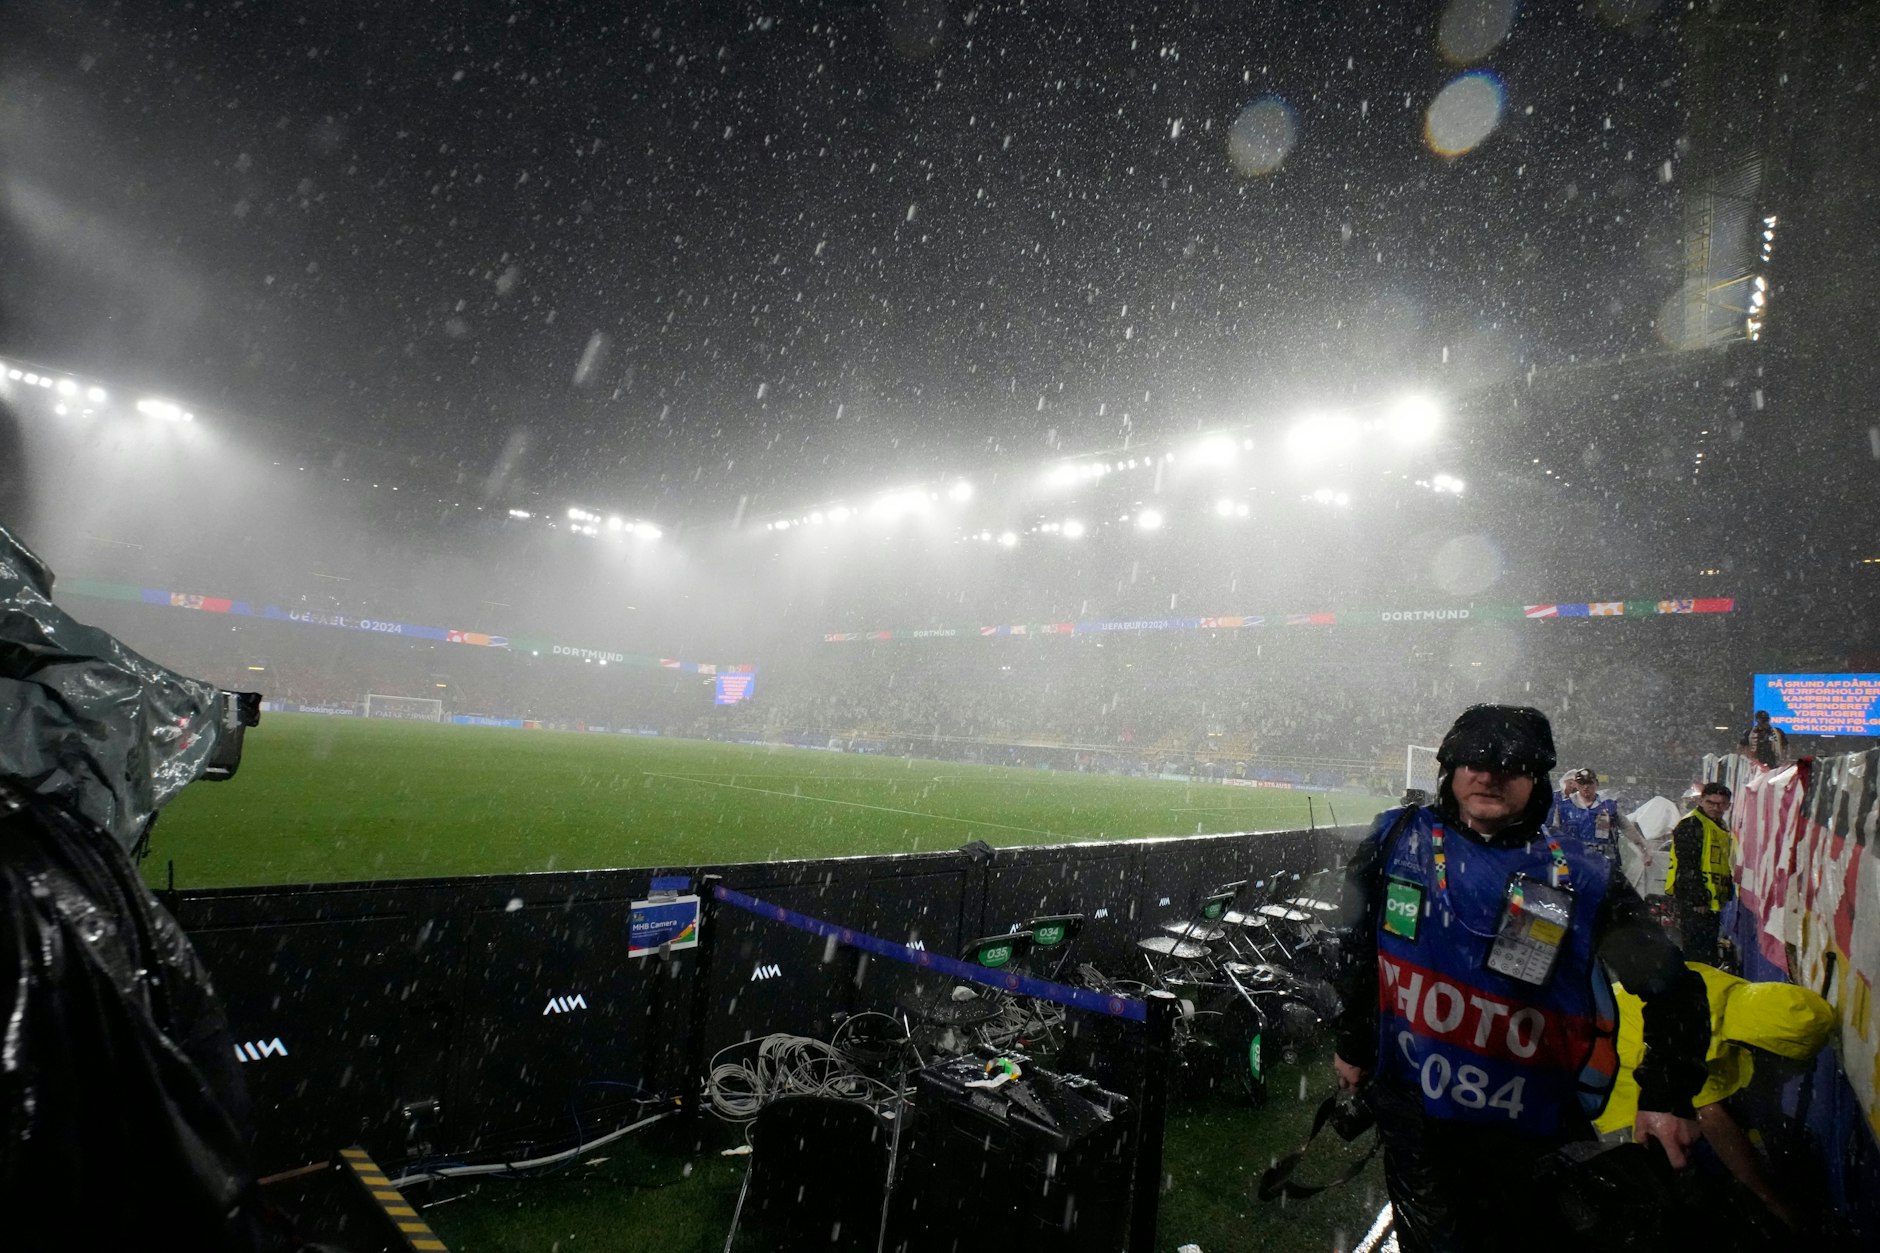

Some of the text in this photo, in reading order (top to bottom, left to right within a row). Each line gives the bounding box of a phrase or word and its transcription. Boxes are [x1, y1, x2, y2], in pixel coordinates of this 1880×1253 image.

[1382, 609, 1470, 620] DORTMUND
[913, 629, 956, 638] DORTMUND
[553, 645, 624, 662] DORTMUND
[1768, 678, 1783, 688] PÅ
[299, 704, 353, 716] Booking.com
[1787, 702, 1873, 710] SUSPENDERET.
[1811, 724, 1843, 732] KORT
[1843, 725, 1867, 733] TID.
[1387, 897, 1418, 917] 019
[632, 919, 678, 931] MHB Camera
[1039, 926, 1059, 937] 034
[986, 946, 1008, 960] 035
